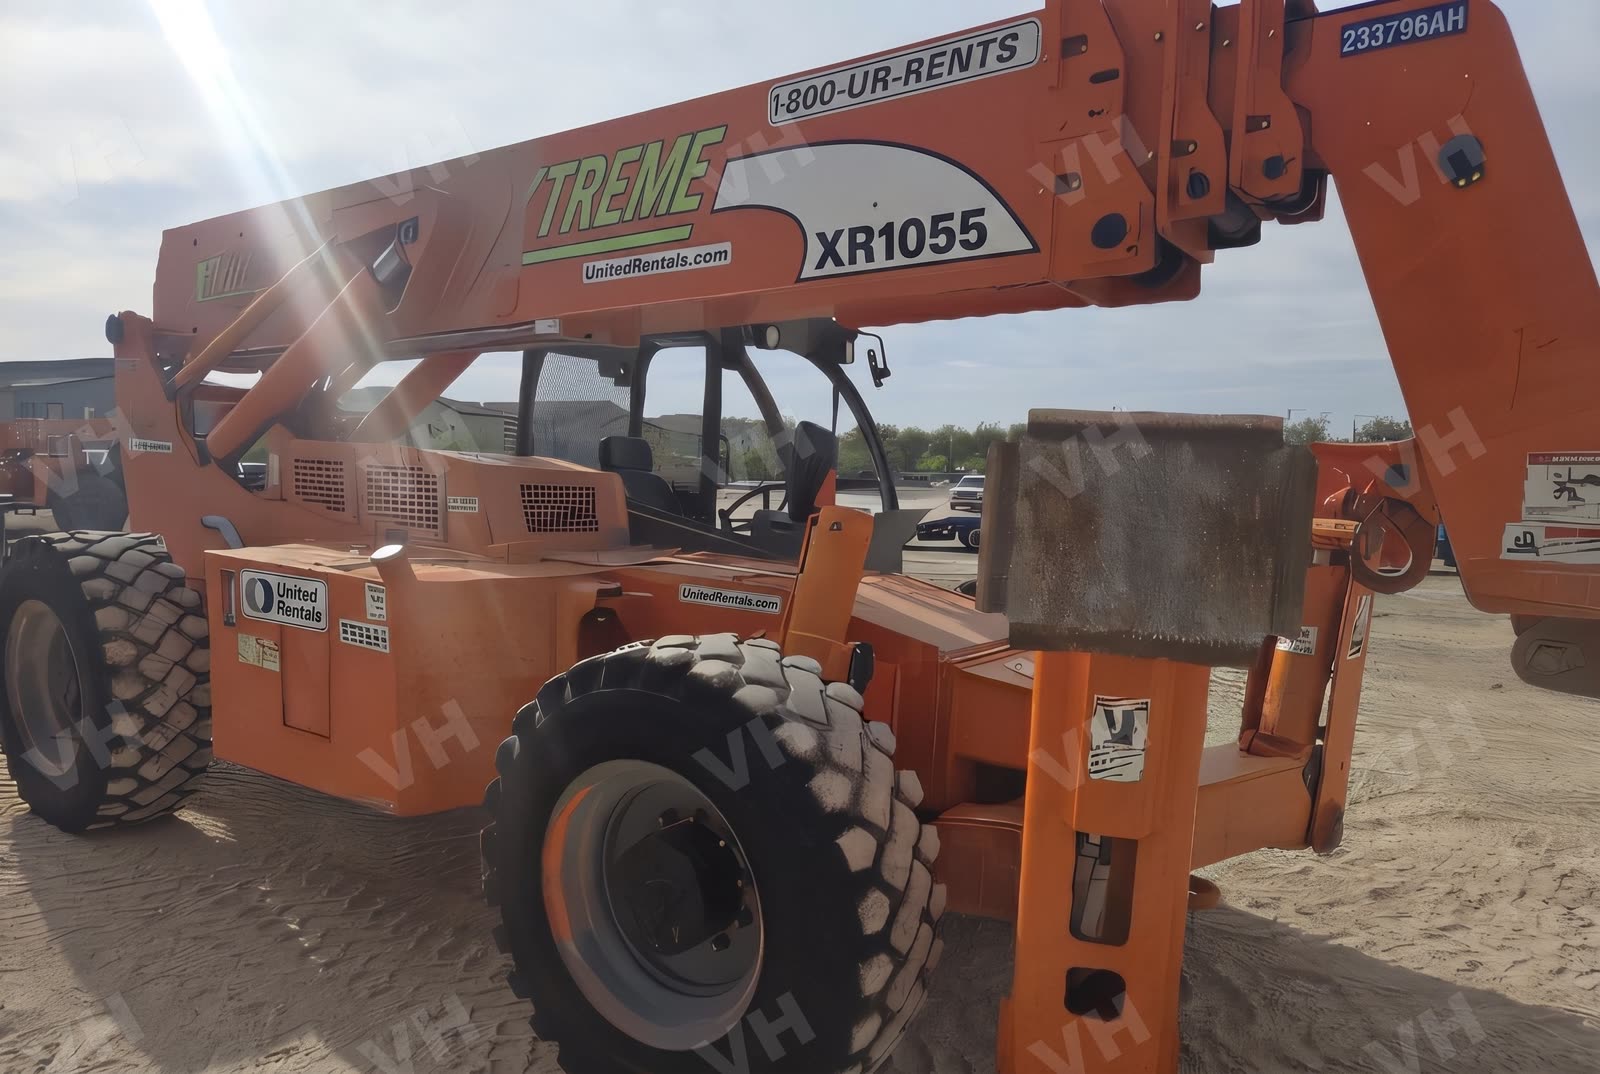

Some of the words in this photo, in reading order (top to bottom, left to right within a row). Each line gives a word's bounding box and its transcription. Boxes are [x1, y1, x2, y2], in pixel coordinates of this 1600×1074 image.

[1342, 5, 1465, 53] 233796AH
[772, 32, 1019, 117] 1-800-UR-RENTS
[814, 207, 988, 271] XR1055
[585, 248, 729, 281] UnitedRentals.com
[276, 581, 318, 604] United
[682, 587, 779, 611] UnitedRentals.com
[276, 599, 323, 624] Rentals
